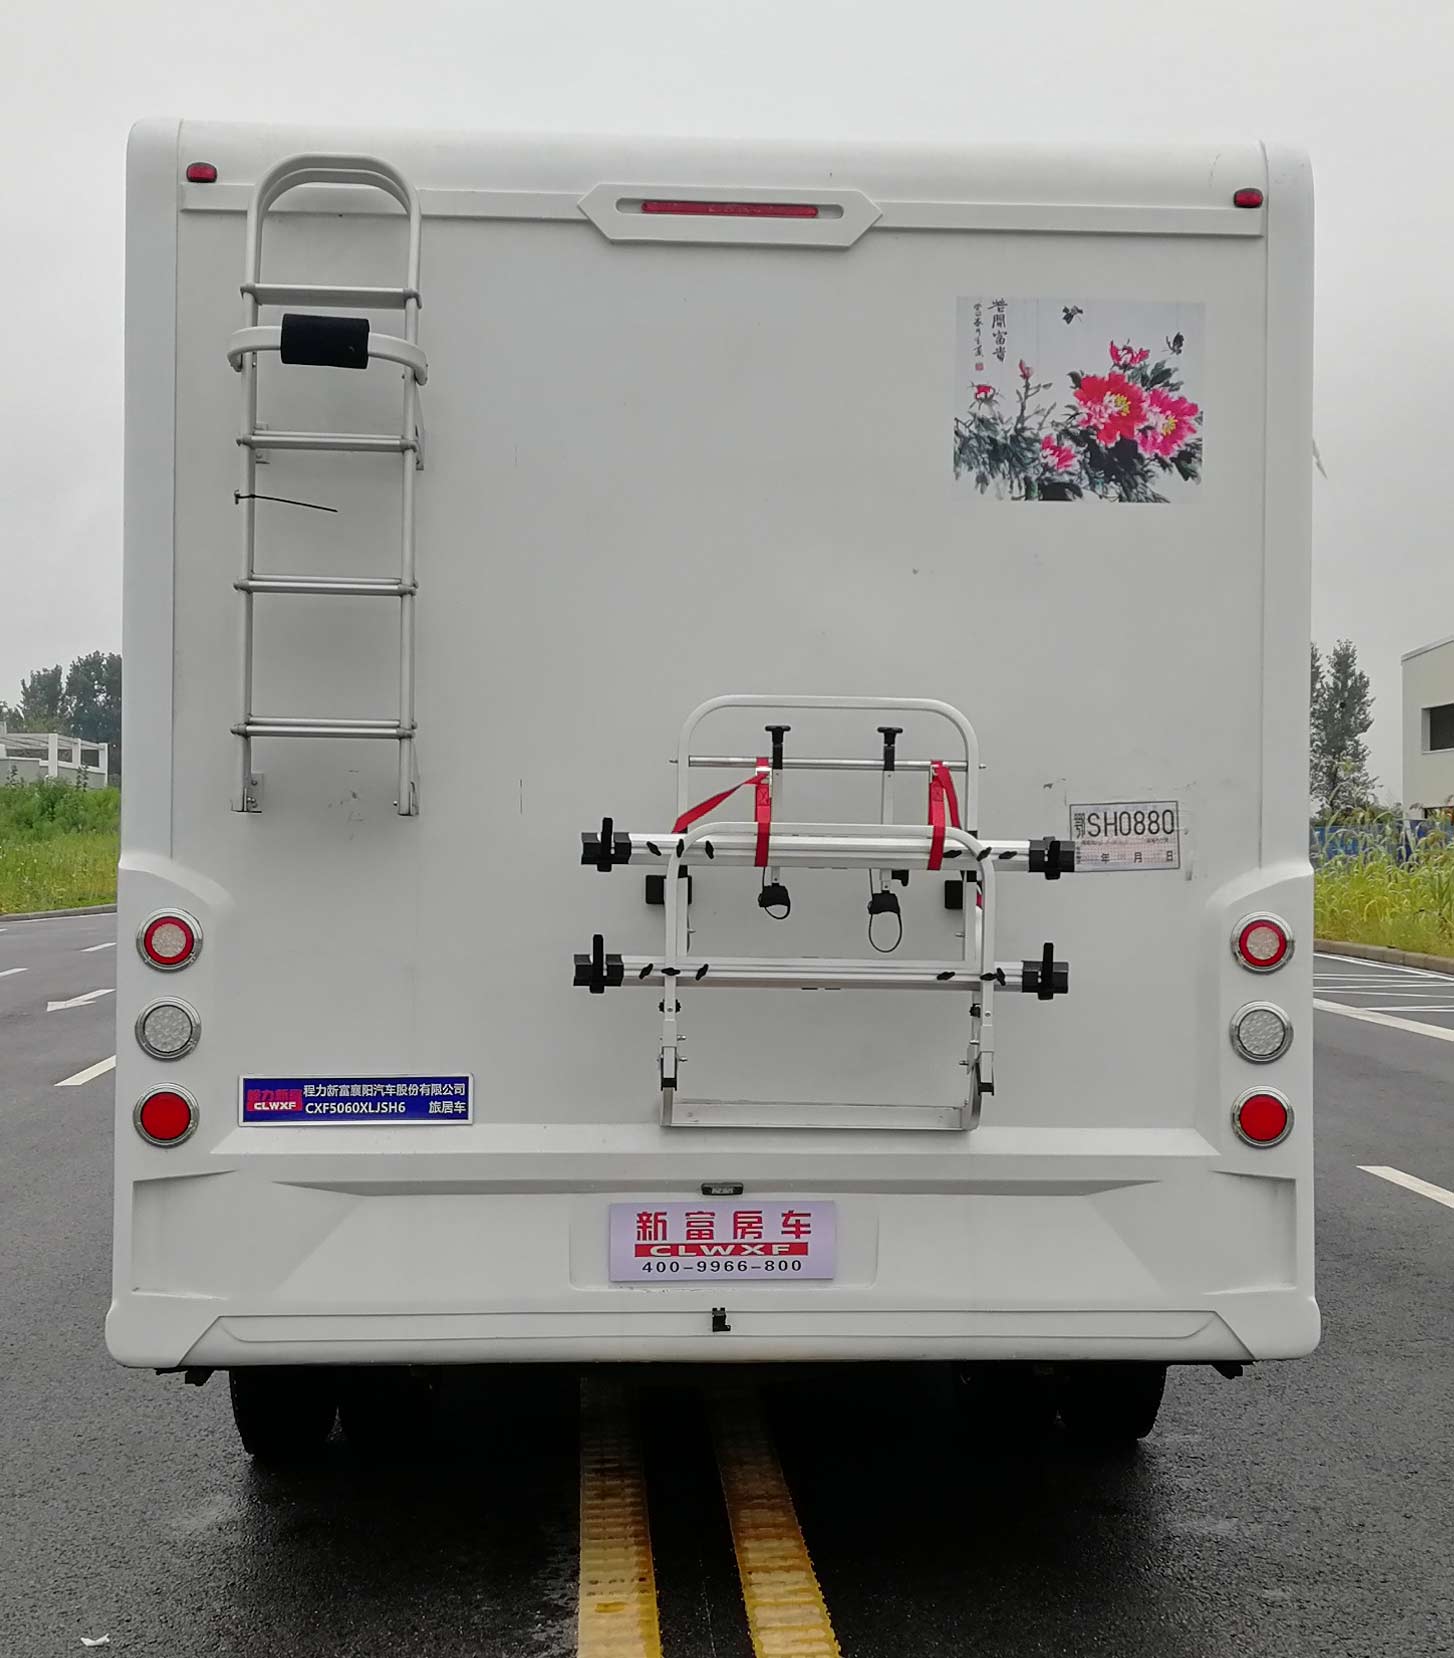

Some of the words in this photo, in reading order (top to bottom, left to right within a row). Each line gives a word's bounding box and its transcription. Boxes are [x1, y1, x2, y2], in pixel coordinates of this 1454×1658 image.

[1134, 851, 1143, 863] 月
[1166, 850, 1174, 862] 日
[254, 1101, 297, 1110] CLWXF
[305, 1101, 406, 1114] CXF5060XLJSH6
[429, 1100, 467, 1114] 旅居车
[636, 1209, 812, 1241] 新富房车
[650, 1243, 791, 1257] CLWXF
[642, 1259, 802, 1273] 400-9966-800
